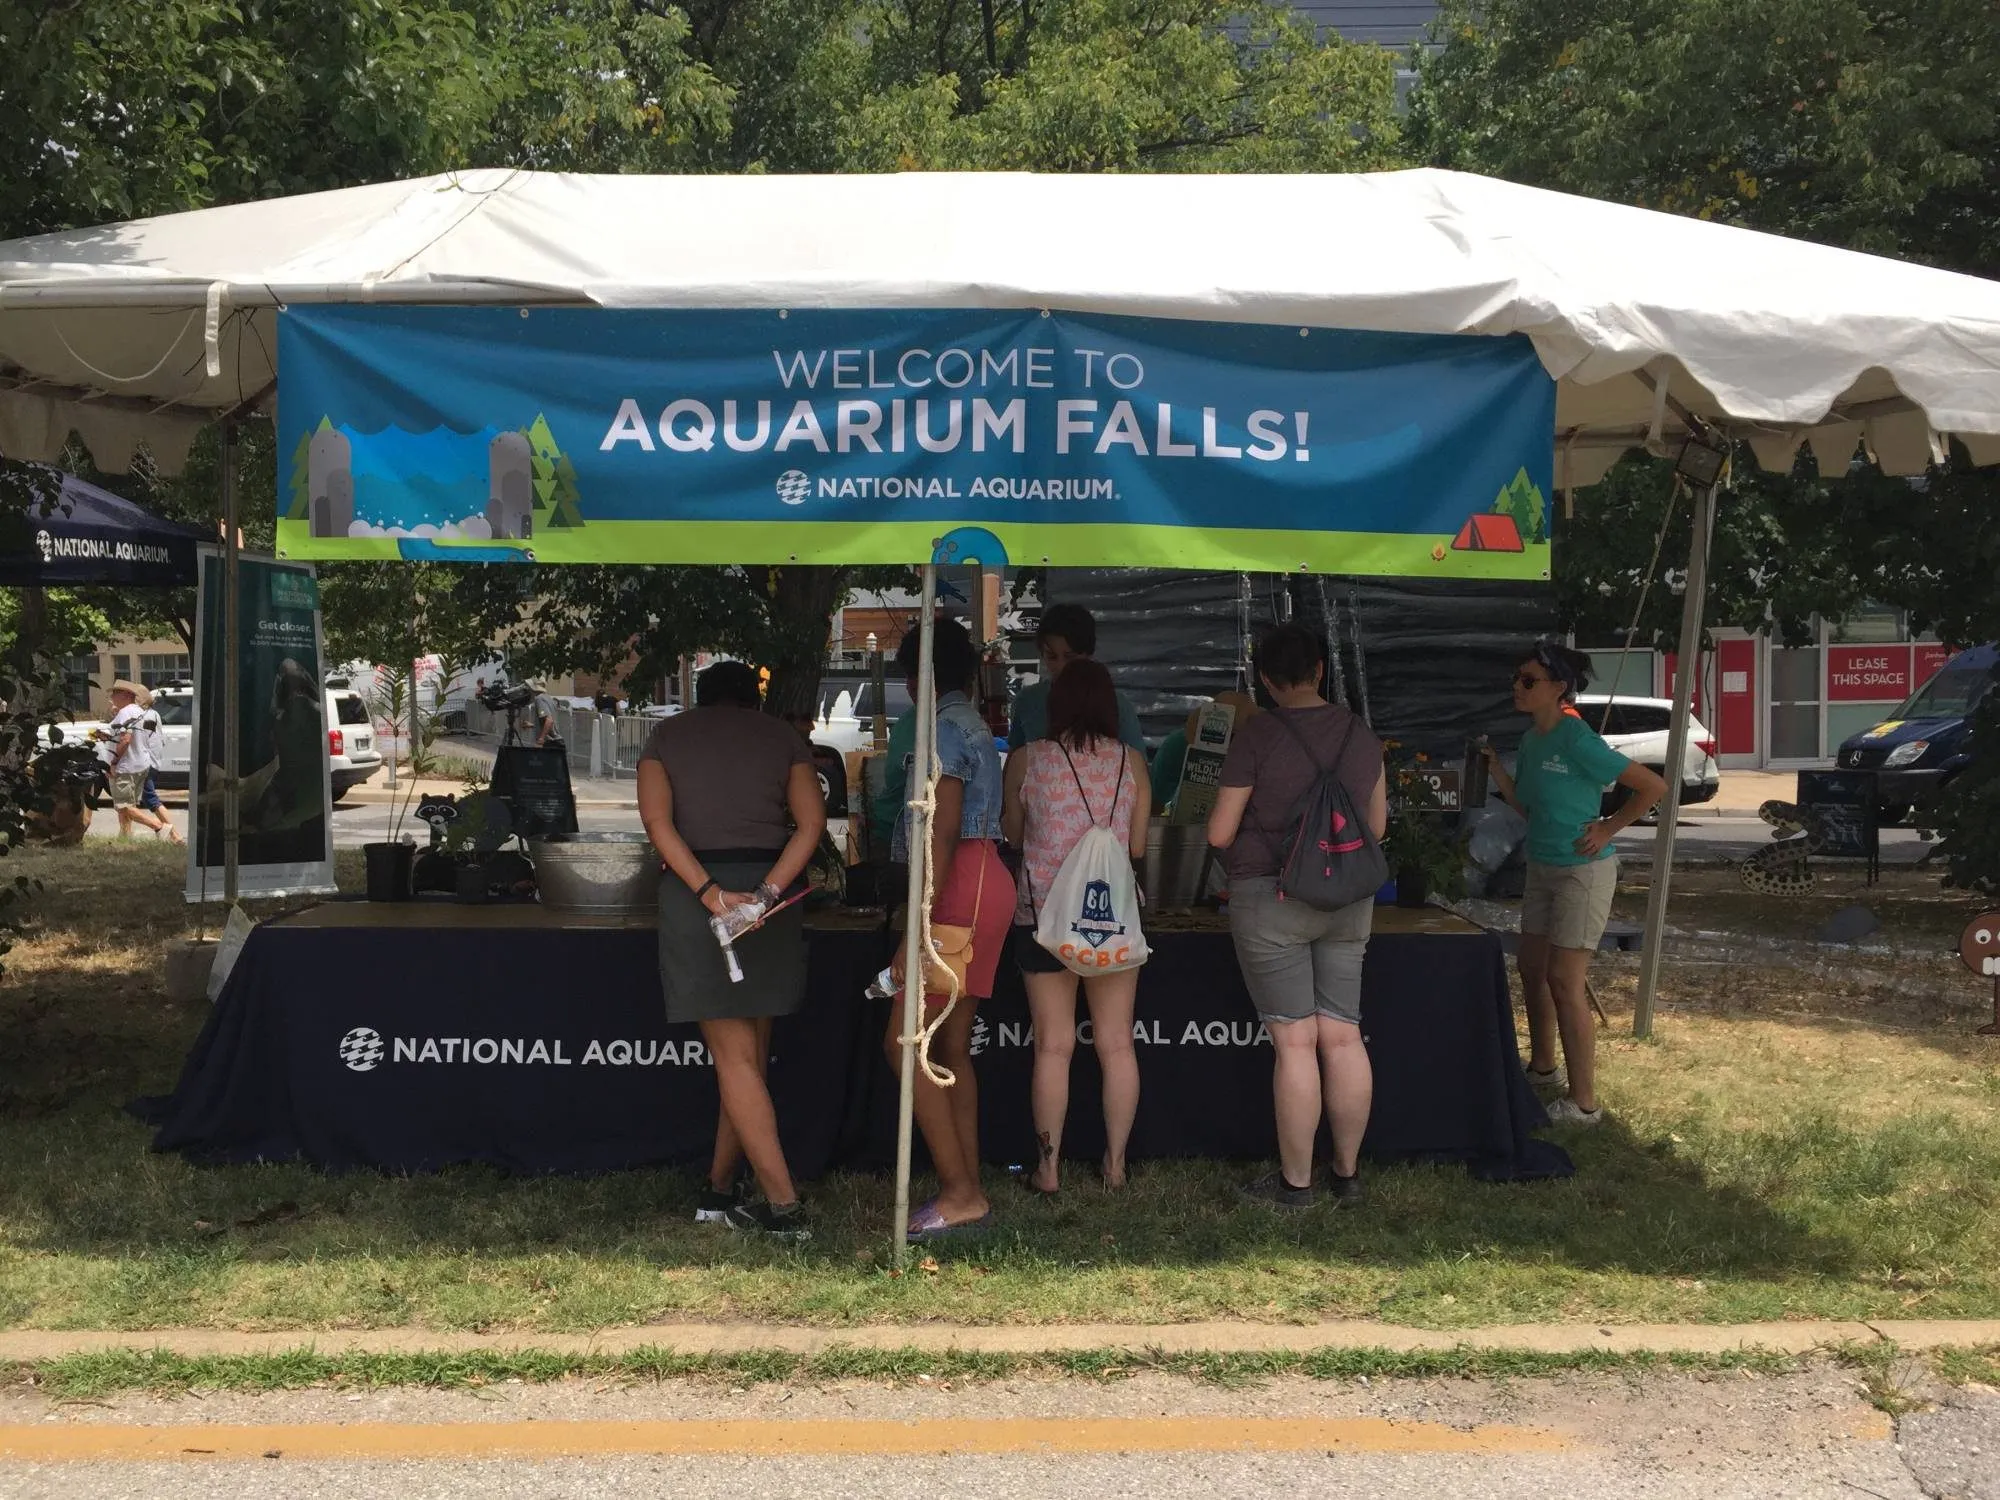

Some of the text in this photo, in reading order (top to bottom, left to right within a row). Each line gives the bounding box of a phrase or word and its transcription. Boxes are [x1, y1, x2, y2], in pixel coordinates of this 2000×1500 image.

[772, 347, 1144, 390] WELCOME TO
[598, 398, 1310, 462] AQUARIUM FALLS!
[818, 476, 961, 499] NATIONAL
[53, 537, 170, 564] NATIONAL AQUARIUM
[258, 620, 278, 631] Get
[1848, 657, 1889, 670] LEASE
[1832, 672, 1905, 686] THIS SPACE
[1086, 887, 1109, 912] 60
[1058, 943, 1130, 968] CCBC
[393, 1037, 714, 1066] NATIONAL AQUARI
